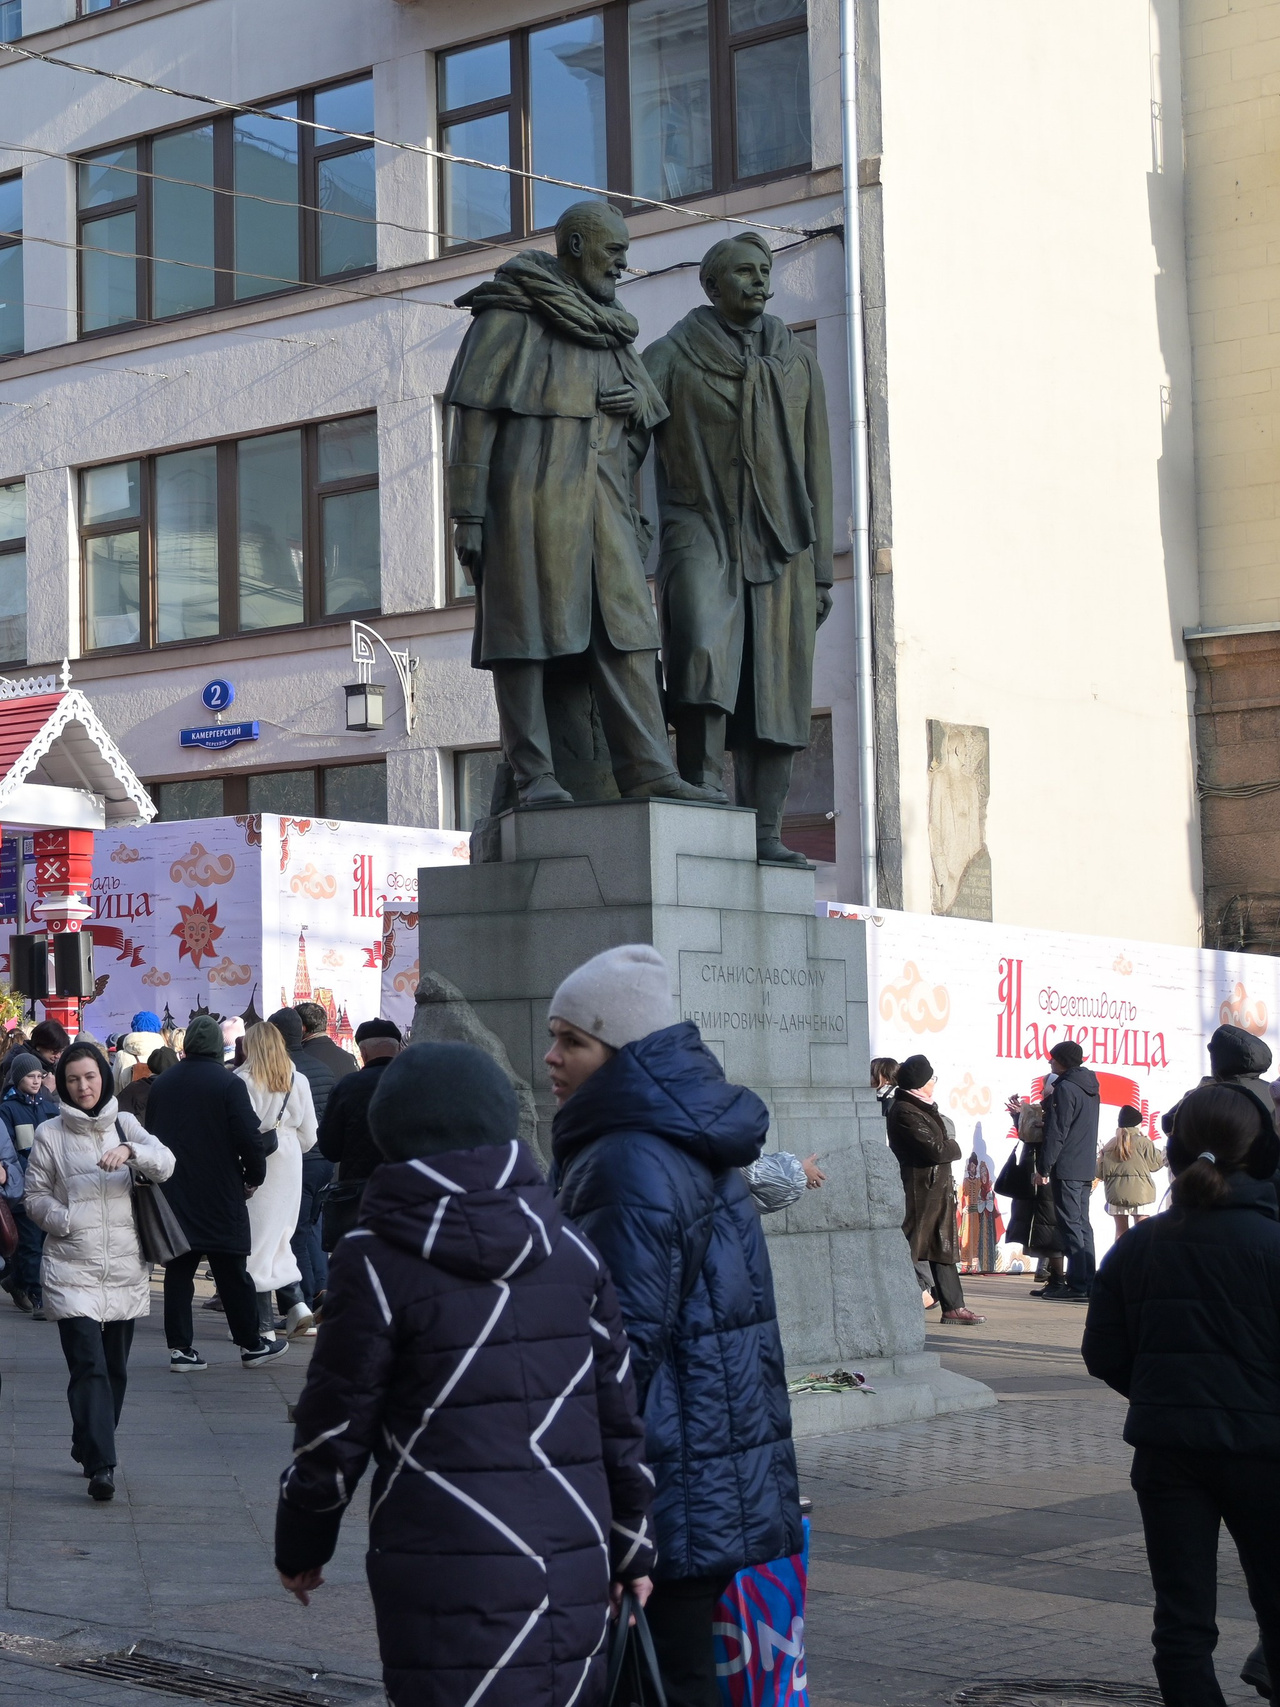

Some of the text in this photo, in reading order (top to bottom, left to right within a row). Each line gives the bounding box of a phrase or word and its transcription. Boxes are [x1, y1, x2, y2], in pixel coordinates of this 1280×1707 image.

[211, 685, 221, 705] 2
[191, 726, 241, 740] КАМЕРГЕРСКИЙ
[701, 964, 826, 987] СТАНИСЛАВСКОМУ
[762, 990, 770, 1007] И
[1038, 986, 1137, 1027] Фестиваль
[683, 1010, 844, 1033] НЕМИРОВИЧУ-ДАНЧЕНКО
